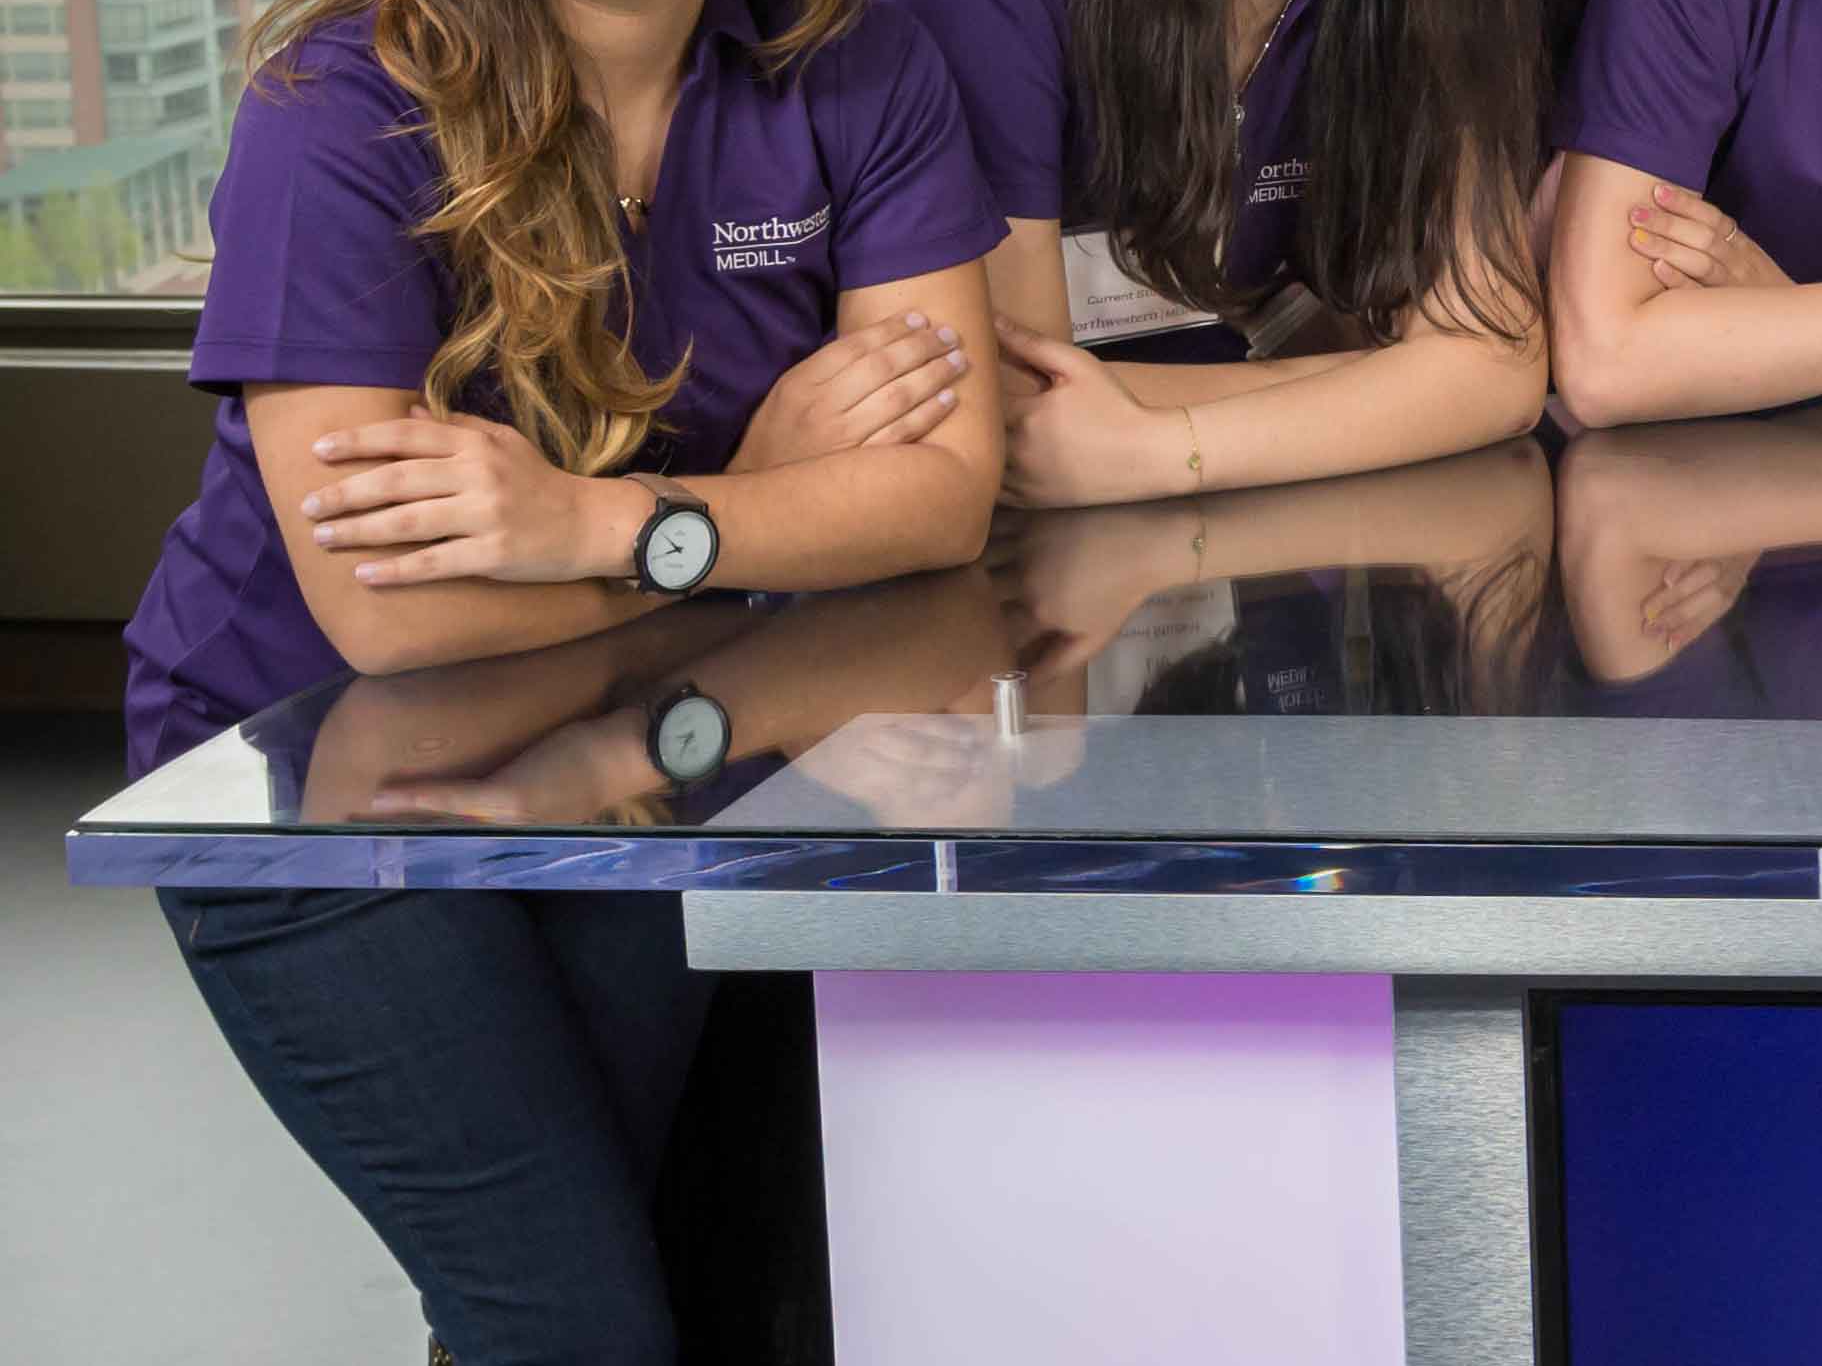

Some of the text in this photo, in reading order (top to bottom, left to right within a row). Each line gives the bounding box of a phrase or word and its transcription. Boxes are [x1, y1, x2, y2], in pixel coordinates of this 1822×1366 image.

[712, 202, 831, 245] Northweste
[715, 249, 787, 272] MEDILL
[1087, 291, 1133, 306] Current
